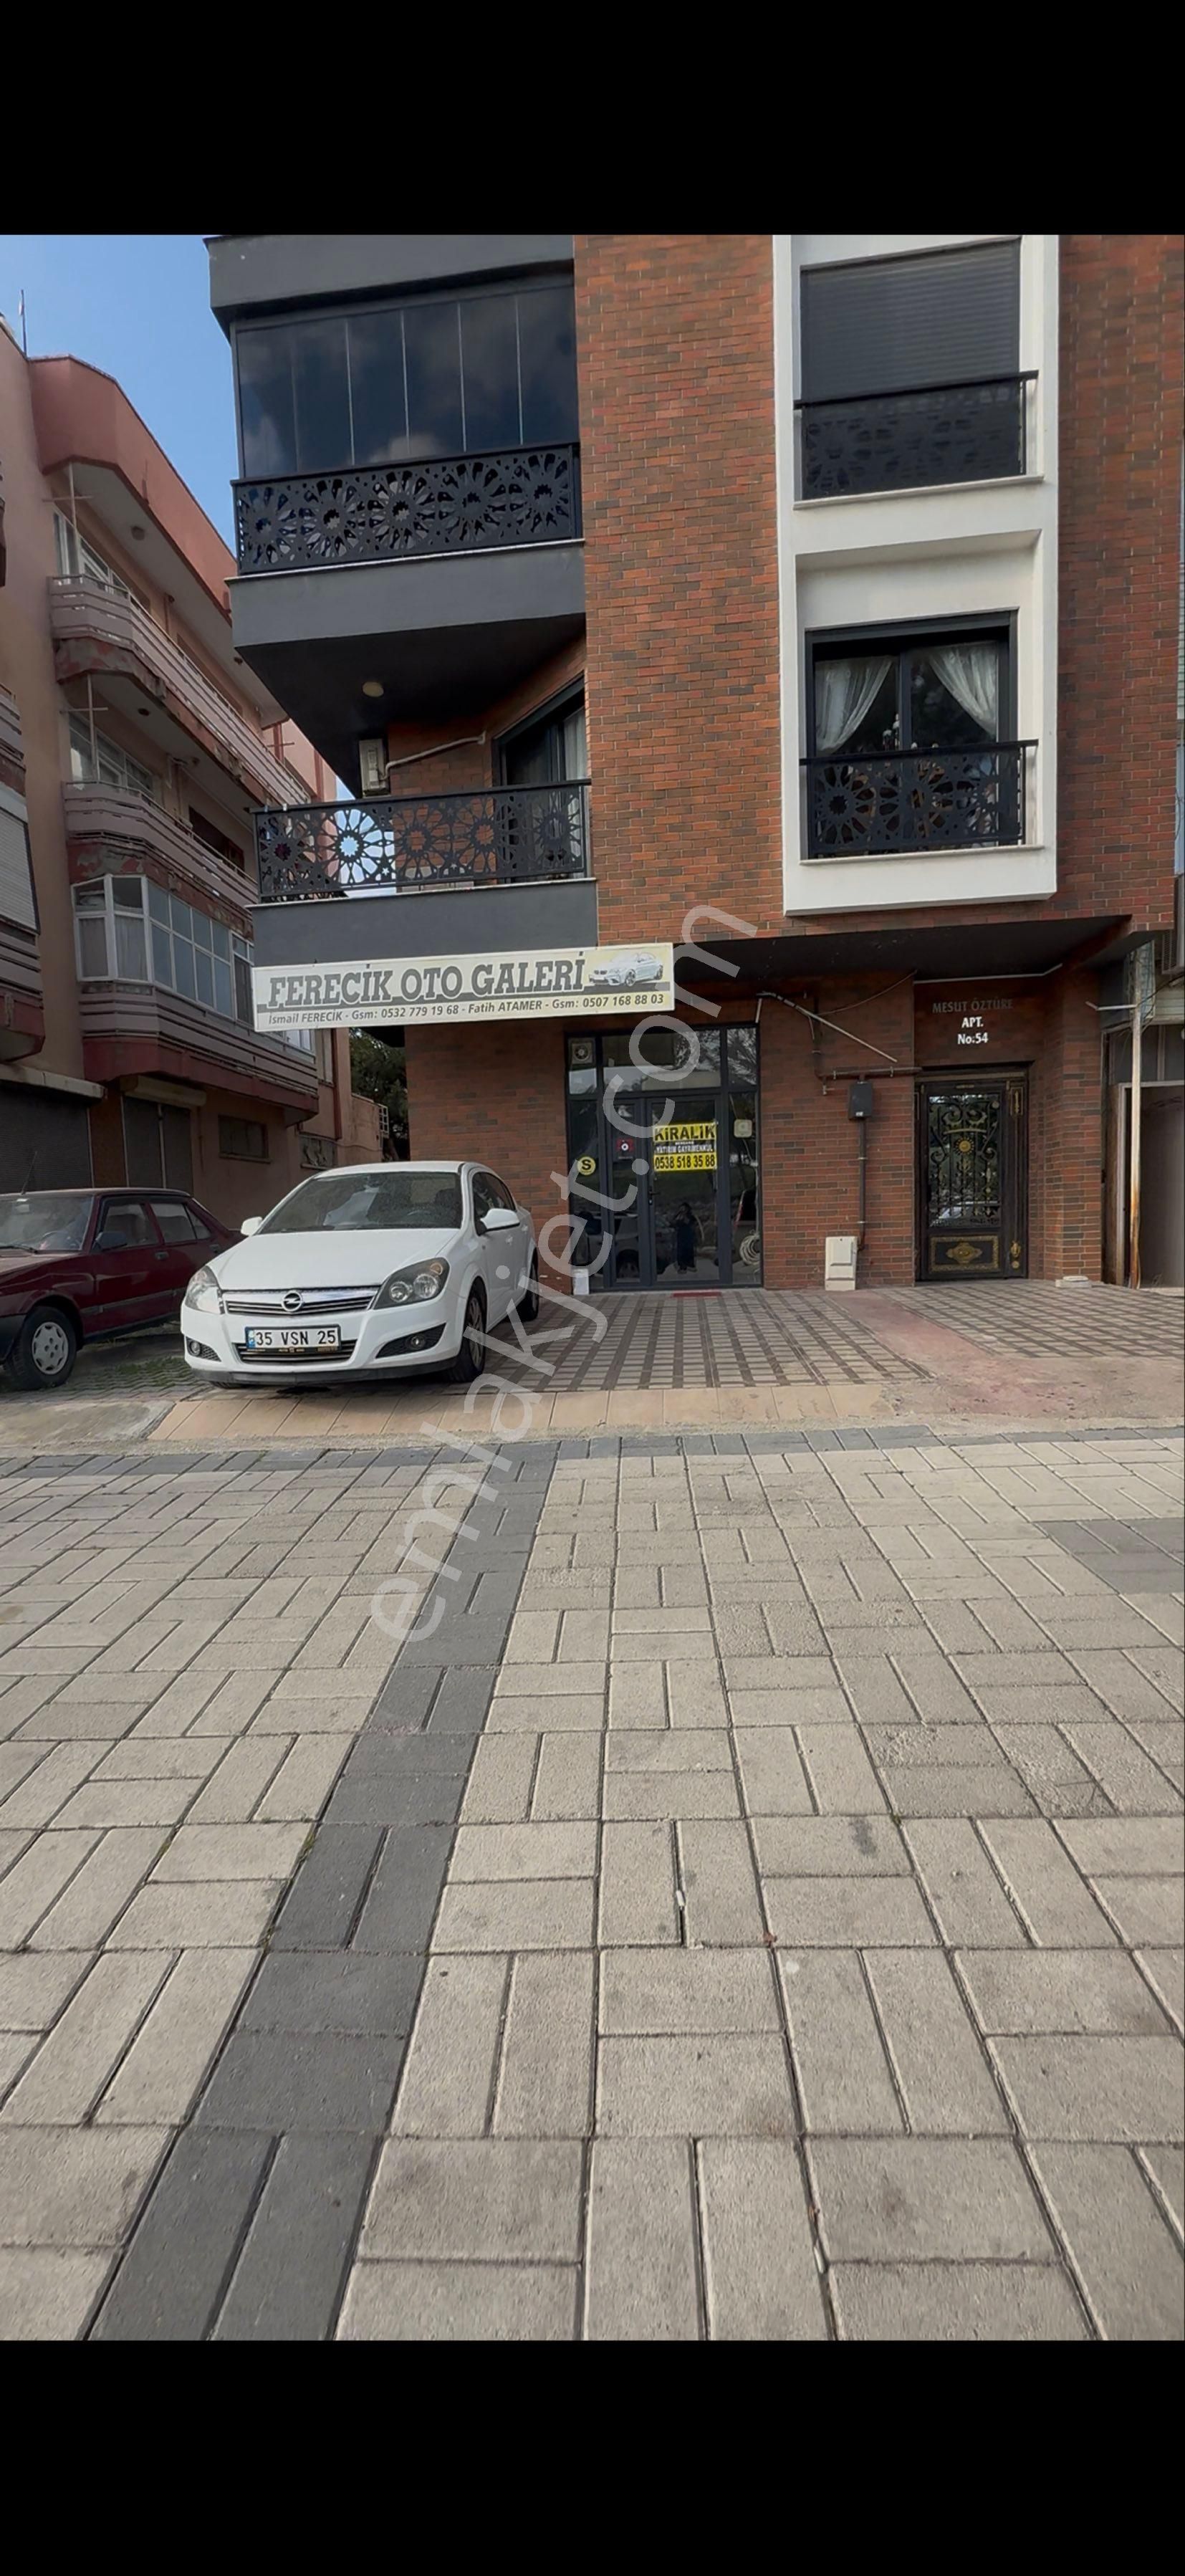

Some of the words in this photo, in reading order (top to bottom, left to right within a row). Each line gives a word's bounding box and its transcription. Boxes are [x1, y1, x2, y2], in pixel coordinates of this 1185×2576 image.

[268, 963, 393, 1006] FERECİK
[400, 965, 462, 1000] OTO
[471, 951, 586, 995] GALERİ
[301, 1008, 342, 1023] FERECİK
[352, 1010, 378, 1020] Gsm:
[381, 1007, 406, 1018] 0532
[409, 1006, 427, 1017] 779
[431, 1005, 443, 1015] 19
[446, 1005, 459, 1015] 68
[468, 1003, 494, 1014] Fatih
[498, 1000, 542, 1012] ATAMER
[552, 999, 578, 1009] Gsm:
[582, 997, 608, 1007] 0507
[613, 995, 631, 1006] 168
[635, 995, 647, 1005] 88
[651, 994, 664, 1004] 03
[932, 1002, 967, 1013] MESUT
[961, 1017, 984, 1028] APT.
[957, 1033, 988, 1045] No:54
[581, 1159, 592, 1171] S
[655, 1157, 675, 1169] 0538
[676, 1156, 691, 1168] 518
[693, 1155, 704, 1167] 35
[705, 1154, 716, 1167] 88
[256, 1332, 273, 1346] 35
[281, 1331, 310, 1345] VSN
[317, 1330, 336, 1344] 25
